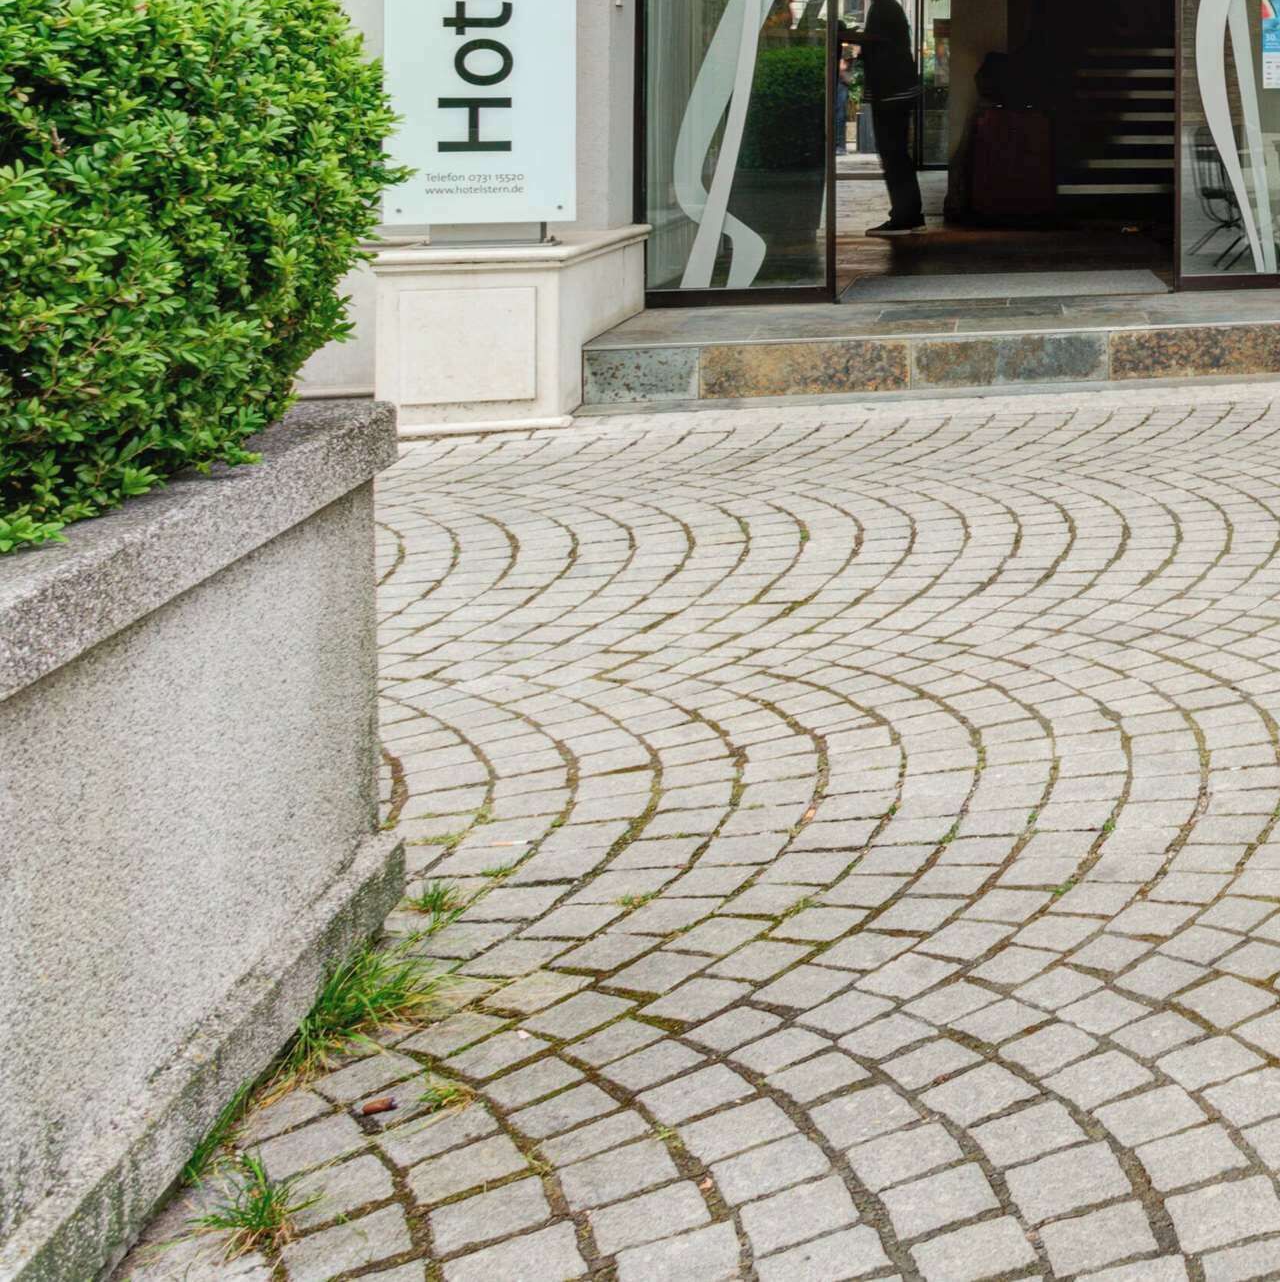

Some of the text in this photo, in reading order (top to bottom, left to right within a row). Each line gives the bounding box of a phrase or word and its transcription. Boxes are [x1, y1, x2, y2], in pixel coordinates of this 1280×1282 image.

[424, 172, 525, 183] Telefon 0731 15520
[424, 184, 525, 195] www.hotelstern.de
